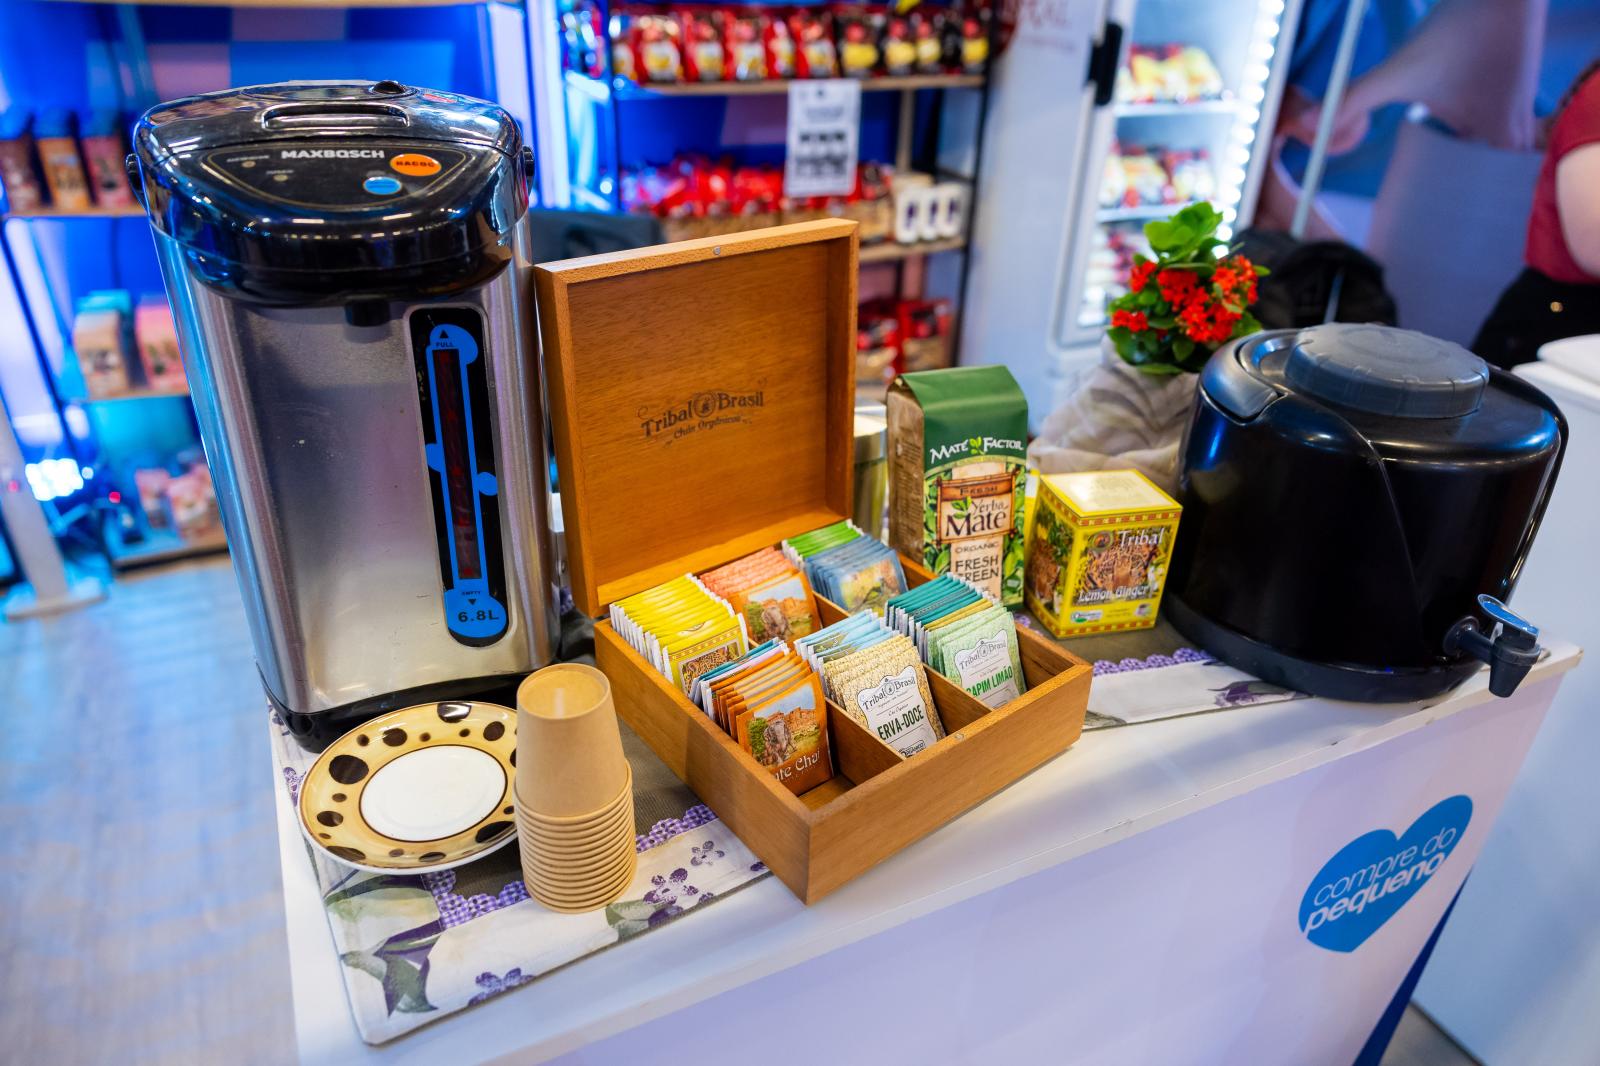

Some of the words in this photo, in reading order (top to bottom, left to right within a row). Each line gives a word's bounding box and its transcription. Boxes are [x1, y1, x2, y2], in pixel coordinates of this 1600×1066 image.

[281, 150, 385, 160] MAXBOSCH
[641, 400, 693, 438] Tribal
[717, 391, 764, 410] Brasil
[983, 436, 1024, 452] FACTOR
[971, 498, 1009, 515] Yerba
[945, 510, 1007, 537] Mate
[954, 541, 1000, 554] ORGANIC
[1117, 527, 1165, 549] Tribal
[955, 555, 999, 573] FRESH
[957, 567, 999, 582] REEN
[1078, 589, 1113, 603] Lemon
[1115, 584, 1150, 601] Ginger
[458, 609, 499, 623] 6.8L
[960, 649, 980, 670] Tribal
[988, 640, 1007, 653] Brasil
[991, 665, 1013, 688] LIMÃO
[863, 687, 886, 711] Tribal
[894, 676, 916, 691] Brasil
[876, 704, 925, 741] ERVA-DOCE
[795, 747, 820, 771] Chai
[1313, 845, 1418, 907] compre
[1422, 827, 1457, 857] do
[1303, 852, 1447, 937] pequeno
